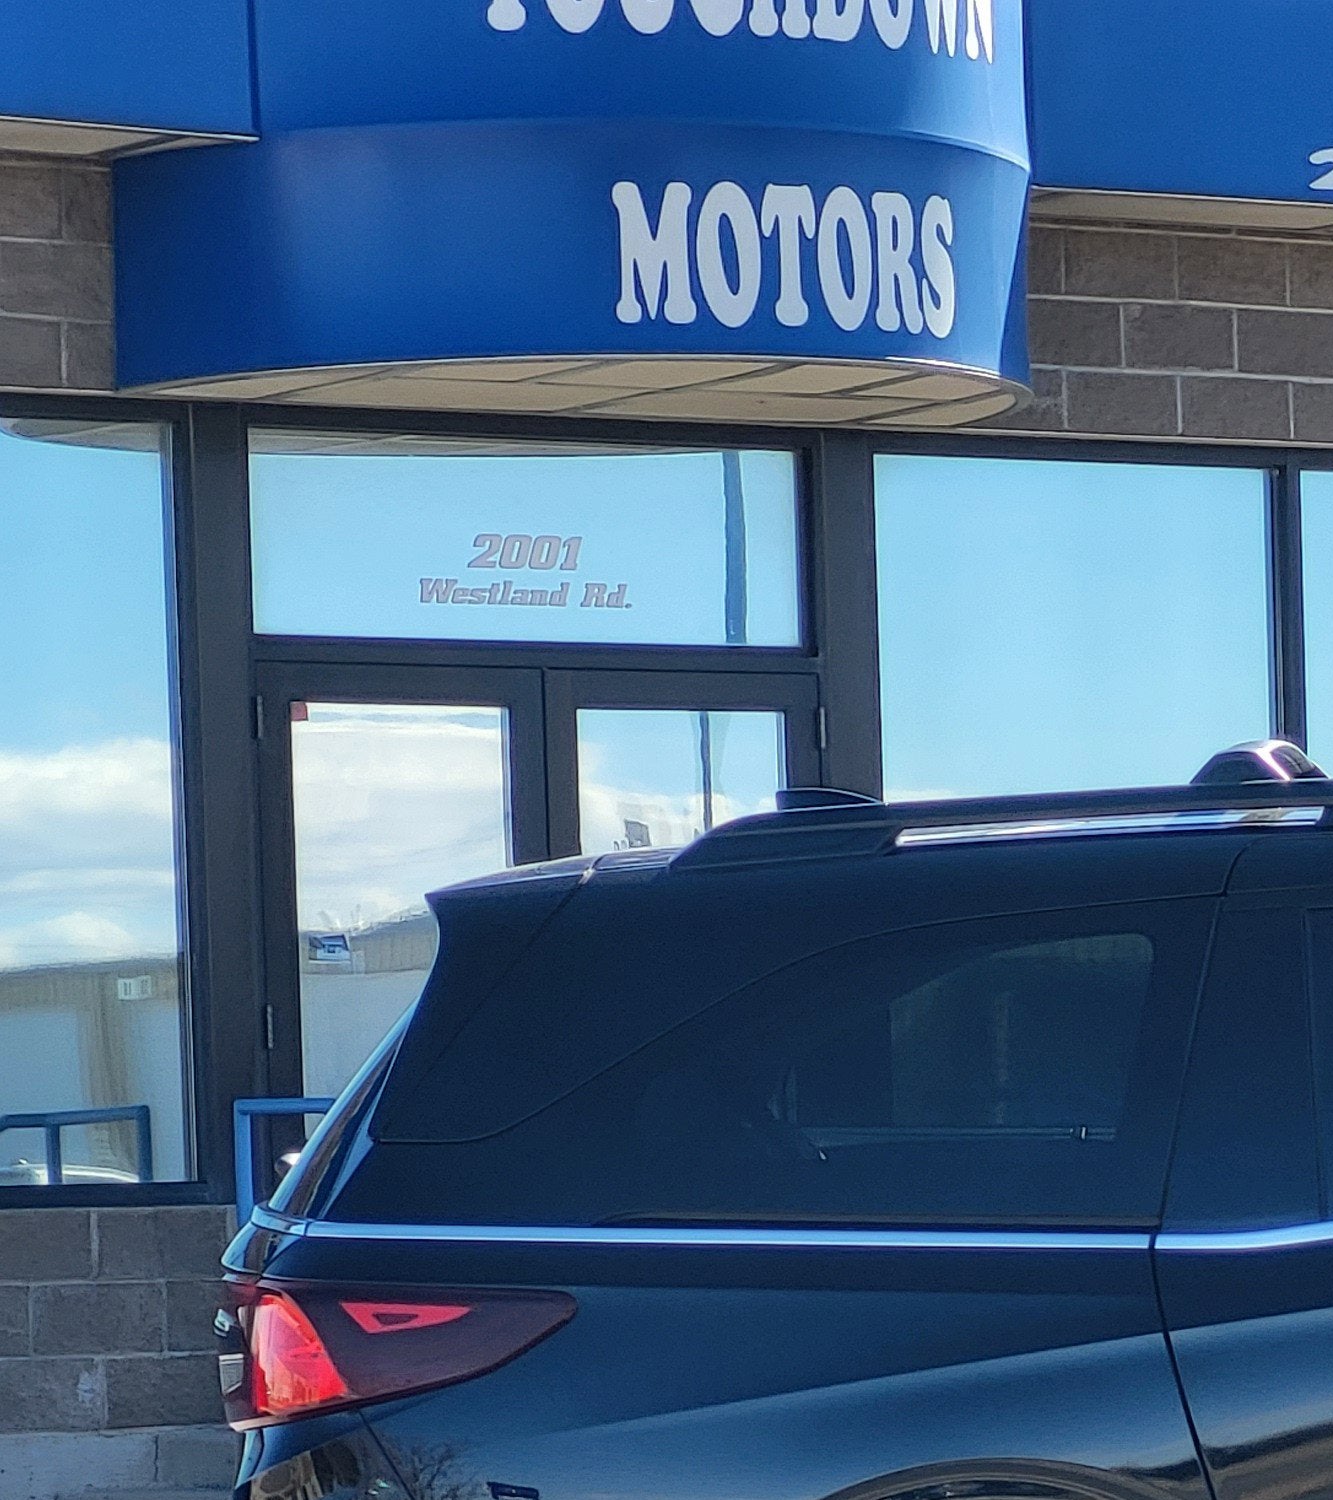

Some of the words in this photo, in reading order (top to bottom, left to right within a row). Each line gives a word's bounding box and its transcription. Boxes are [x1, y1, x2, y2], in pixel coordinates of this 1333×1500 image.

[611, 181, 955, 338] MOTORS
[467, 533, 583, 570] 2001
[419, 578, 570, 607] Westland
[580, 583, 632, 609] Rd.
